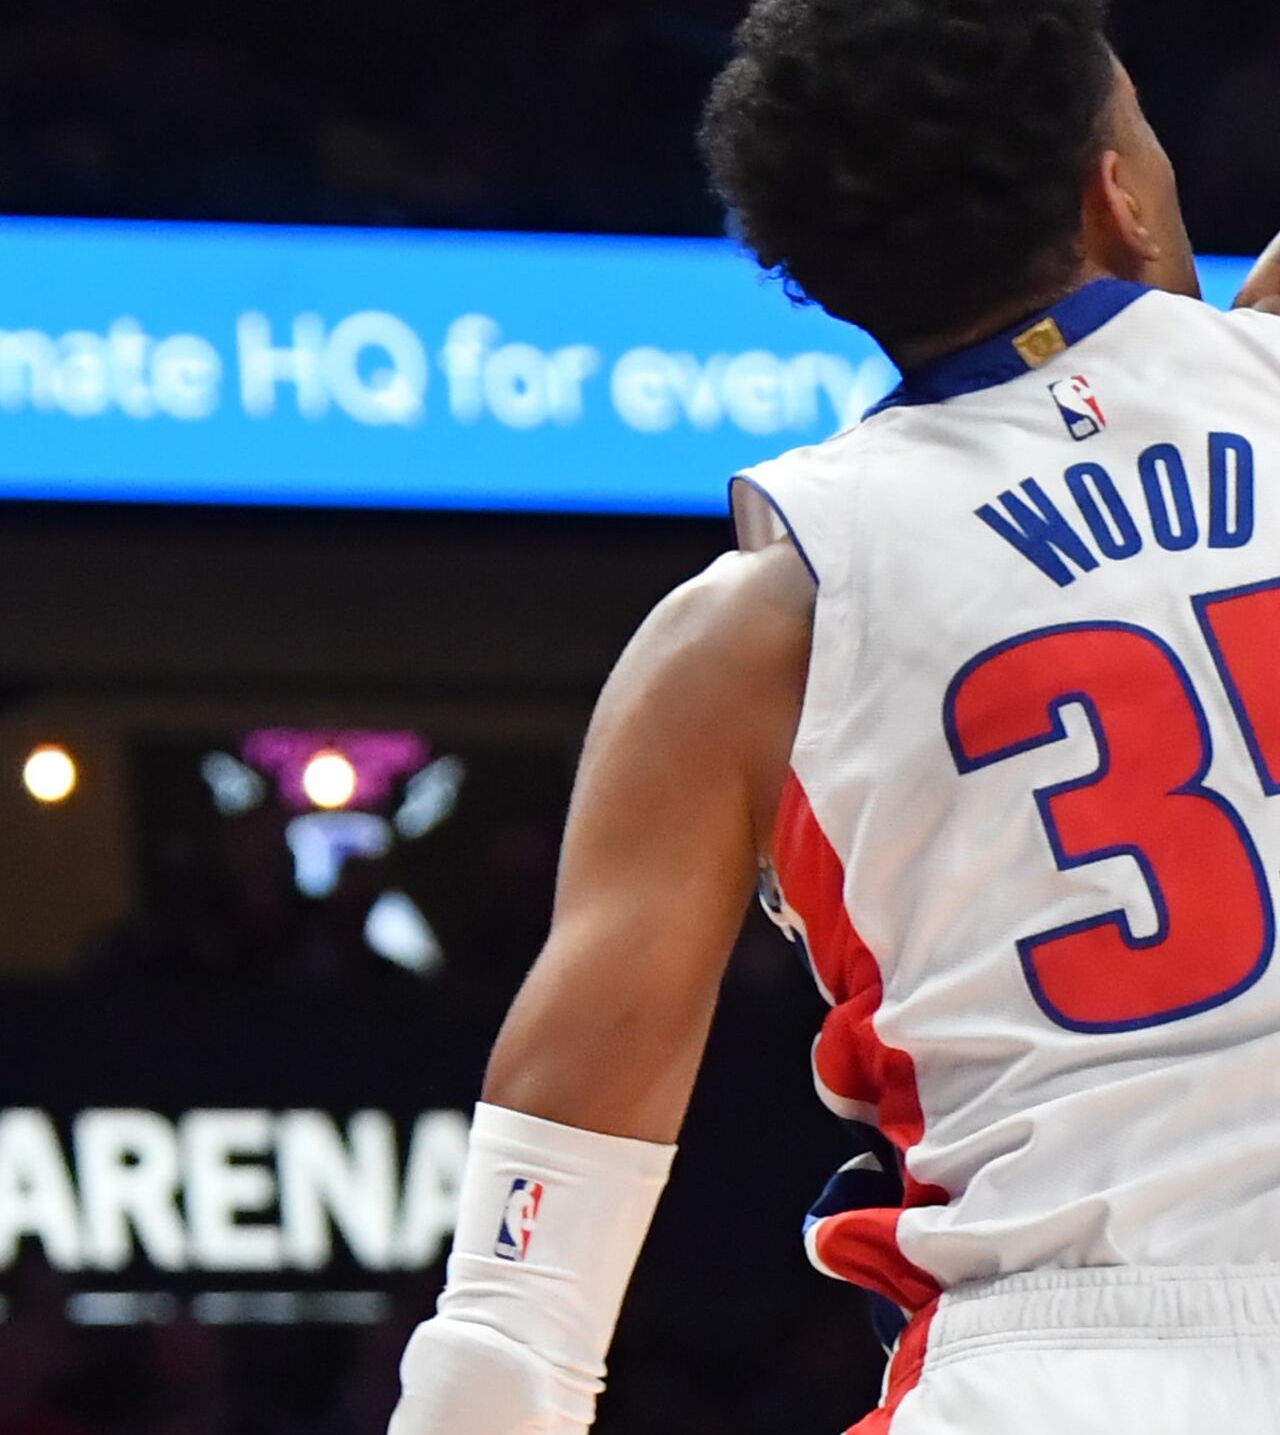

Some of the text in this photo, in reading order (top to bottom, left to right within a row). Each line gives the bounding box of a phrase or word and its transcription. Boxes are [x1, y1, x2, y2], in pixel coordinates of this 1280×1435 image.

[237, 310, 428, 427] HQ
[444, 314, 602, 431] for
[974, 431, 1255, 588] WOOD
[0, 1106, 474, 1273] ARENA
